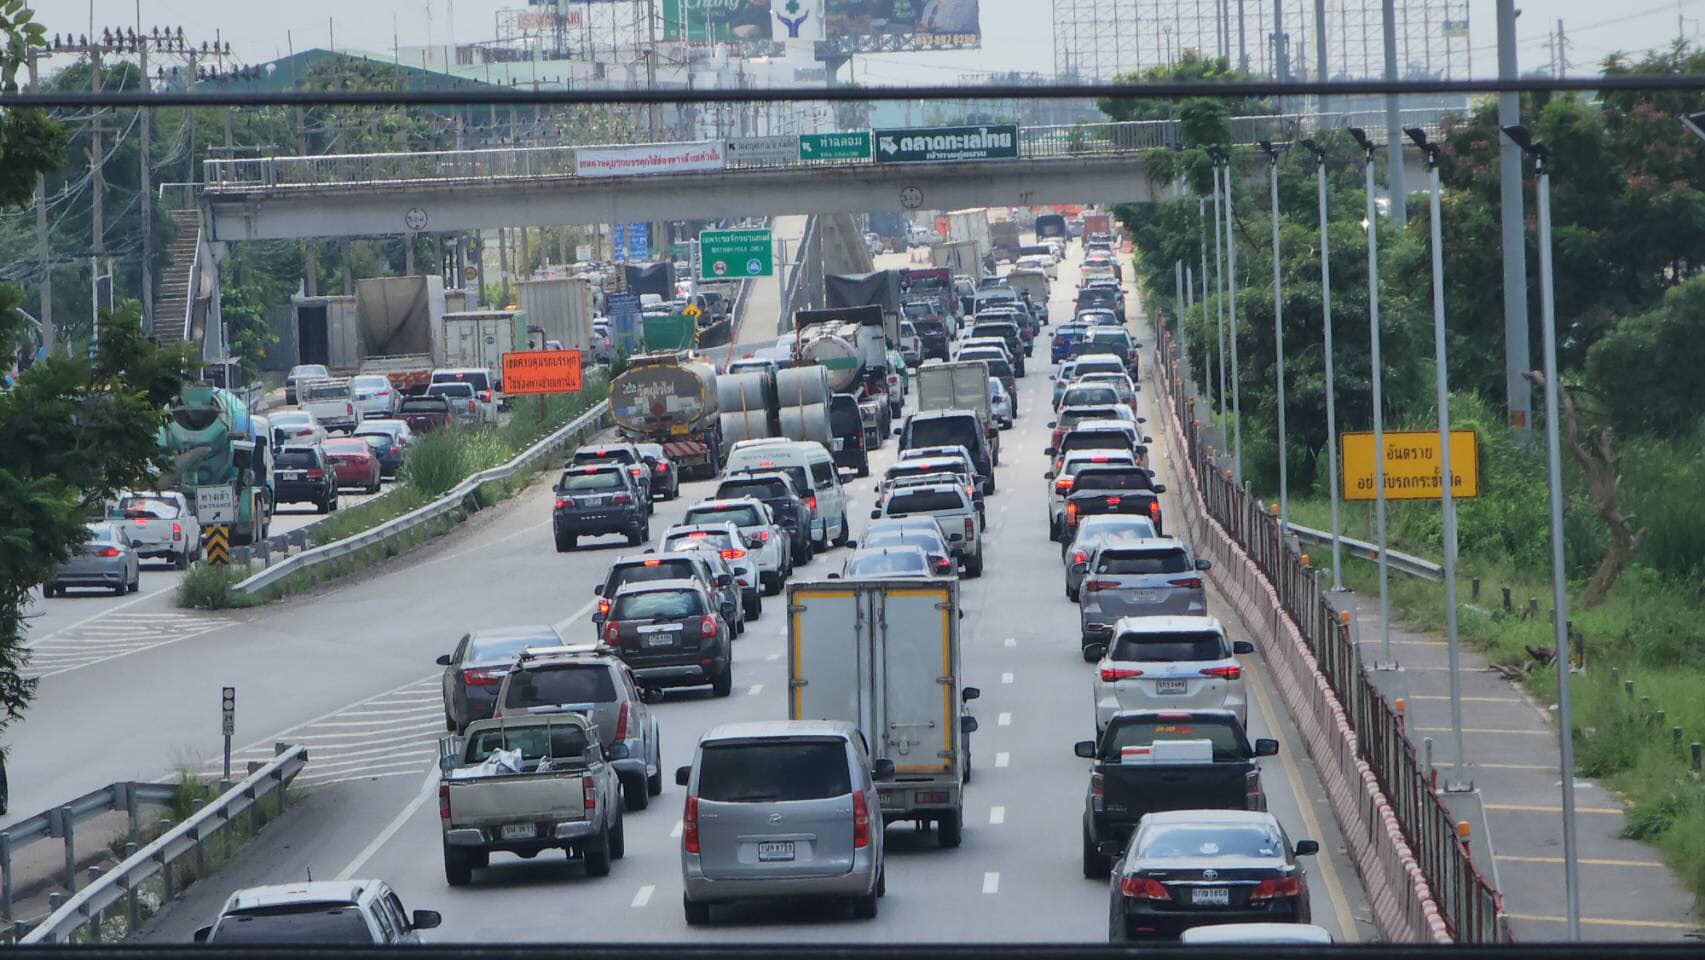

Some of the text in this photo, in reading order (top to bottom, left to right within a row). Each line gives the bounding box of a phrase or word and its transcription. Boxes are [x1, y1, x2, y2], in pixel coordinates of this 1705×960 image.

[820, 136, 862, 148] ท่าฉลอม
[900, 127, 1012, 151] ตลาดทะเลไทย
[506, 356, 577, 369] เขตควบคุมรถบรรทุก
[1386, 443, 1433, 460] อันตราย
[201, 490, 230, 501] ทางเข้า
